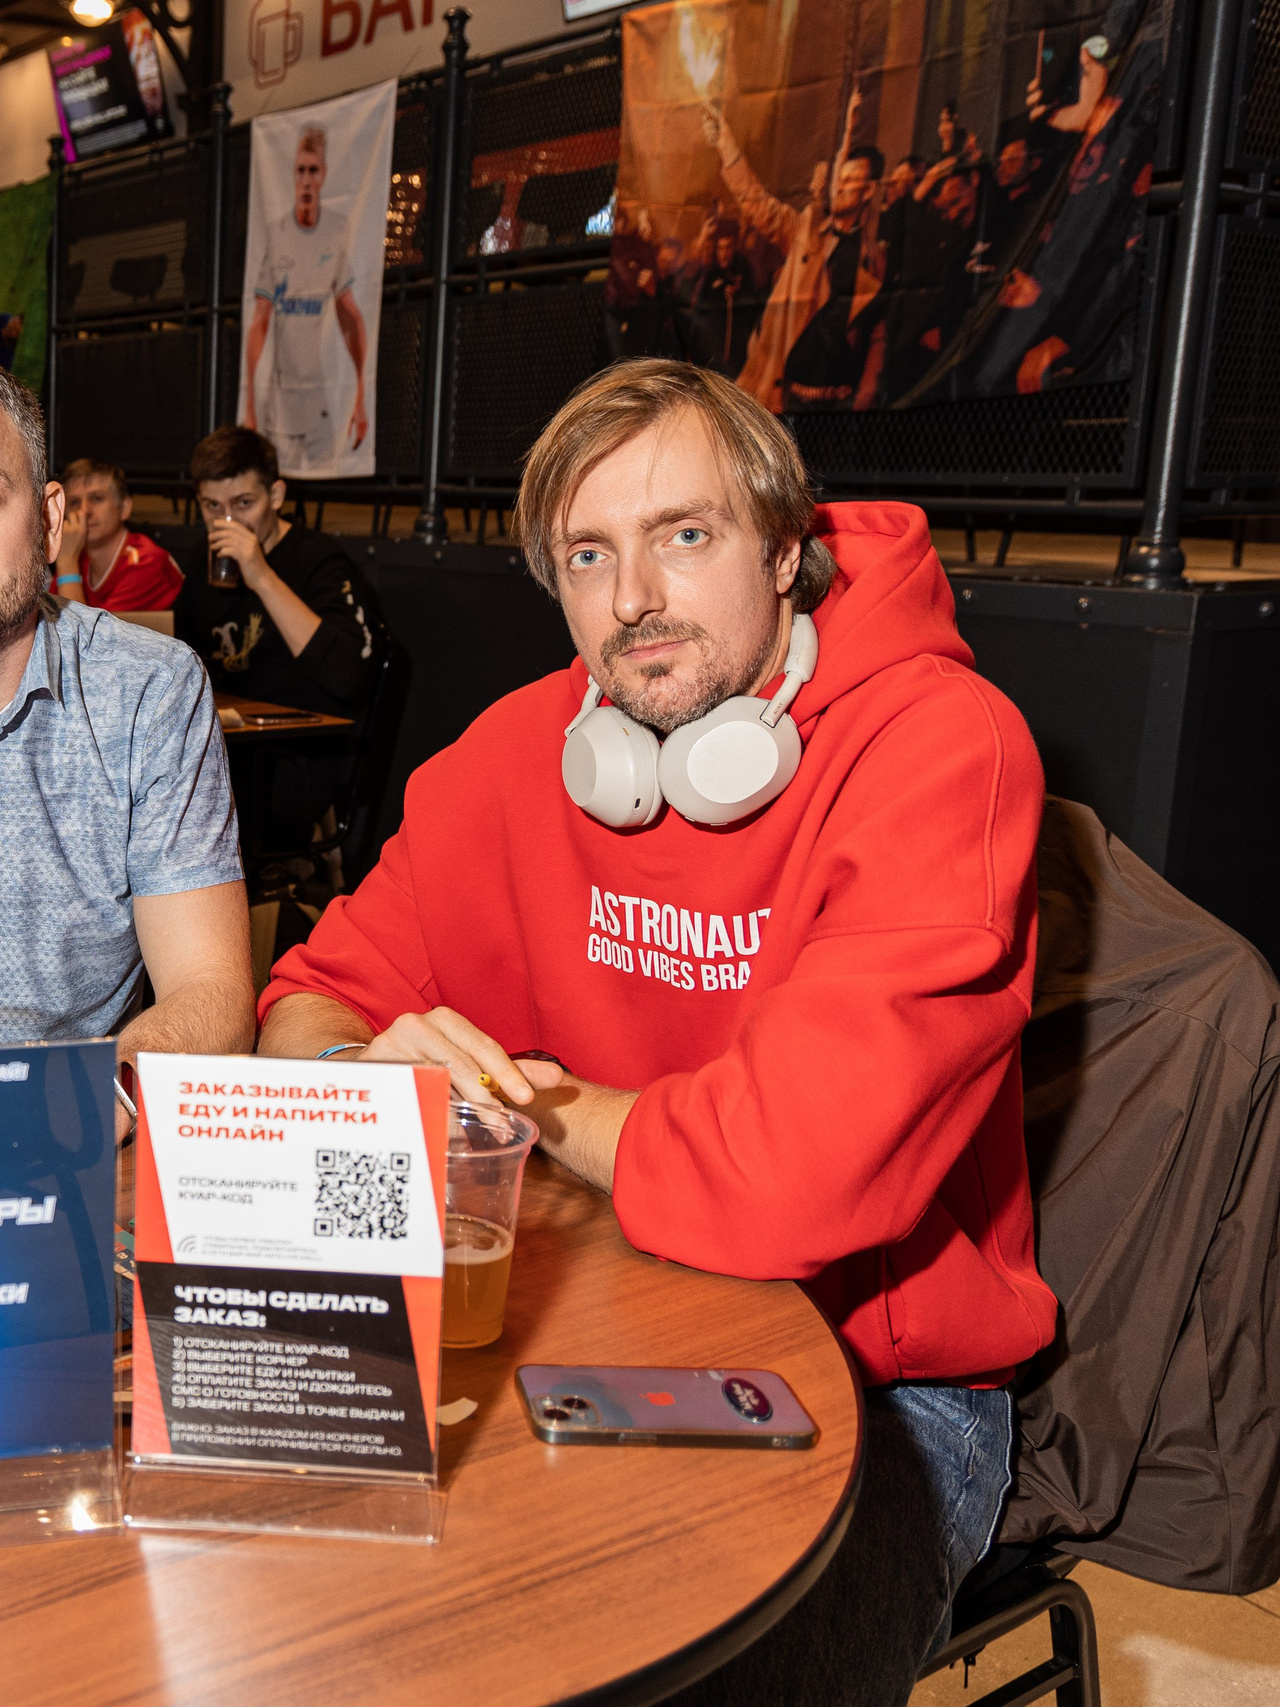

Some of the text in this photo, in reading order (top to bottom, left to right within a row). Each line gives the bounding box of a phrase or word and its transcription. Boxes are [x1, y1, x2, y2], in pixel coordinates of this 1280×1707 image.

[587, 933, 634, 974] GOOD
[638, 948, 695, 991] VIBES
[178, 1081, 371, 1103] ЗАКАЗЫВАЙТЕ
[178, 1103, 378, 1125] ЕДУ И НАПИТКИ
[178, 1124, 284, 1142] ОНЛАЙН
[177, 1176, 298, 1191] ОТСКАНИРУЙТЕ
[177, 1191, 253, 1204] КУАР-КОД
[174, 1285, 389, 1314] ЧТОБЫ СДЕЛАТЬ
[174, 1306, 266, 1328] ЗАКАЗ:
[172, 1347, 308, 1367] 2) ВЫБЕРИТЕ КОРНЕР
[173, 1335, 350, 1359] 1) ОТСКАНИРУЙТЕ КУАР-КОД
[172, 1360, 356, 1382] 3) ВЫБЕРИТЕ ЕДУ И НАПИТКИ
[171, 1384, 299, 1402] СМС О ГОТОВНОСТИ
[172, 1372, 392, 1397] 4) ОПЛАТИТЕ ЗАКАЗ И ДОЖДИТЕСЬ
[171, 1396, 405, 1421] 5) ЗАБЕРИТЕ ЗАКАЗ В ТОЧКЕ ВЫДАЧИ
[214, 1424, 250, 1436] ЗАКАЗ
[250, 1426, 259, 1436] В
[309, 1430, 325, 1440] ИЗ
[326, 1431, 385, 1445] КОРНЕРОВ
